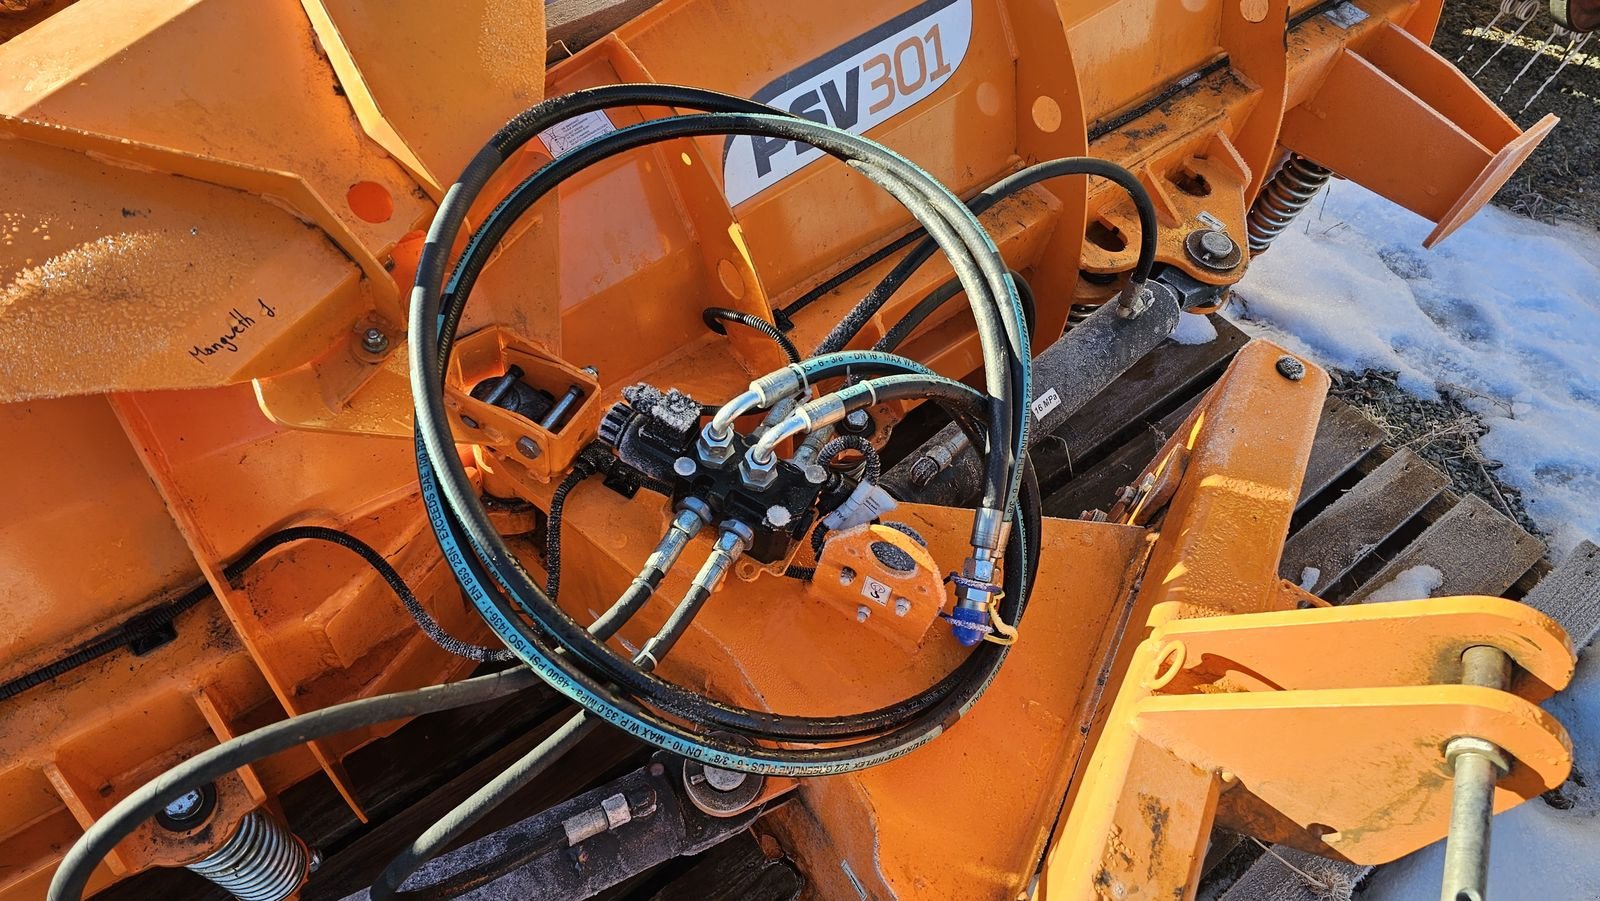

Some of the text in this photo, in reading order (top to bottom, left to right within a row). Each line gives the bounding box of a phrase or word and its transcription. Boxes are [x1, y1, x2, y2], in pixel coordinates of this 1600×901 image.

[818, 359, 824, 367] 6
[854, 351, 868, 361] DN
[884, 353, 902, 365] MAX
[1034, 393, 1057, 414] 16 MPa
[418, 452, 429, 470] 100
[421, 470, 434, 492] SAE
[425, 492, 449, 541] EXCEEDS
[446, 545, 463, 568] 2SN
[458, 567, 473, 587] 853
[468, 584, 483, 601] EN
[483, 605, 510, 635] 1436-1
[508, 633, 527, 652] ISO
[528, 653, 548, 672] PSI
[546, 667, 570, 689] 4800
[575, 688, 598, 709] MPa
[597, 703, 619, 722] 33.0
[641, 727, 666, 746] MAX
[672, 740, 684, 751] 10
[685, 747, 703, 759] DN
[884, 738, 928, 761] DUNLOP
[735, 759, 744, 769] 6
[750, 762, 777, 775] PLUS
[777, 764, 833, 775] GREENLINE
[853, 755, 885, 770] HIFLEX
